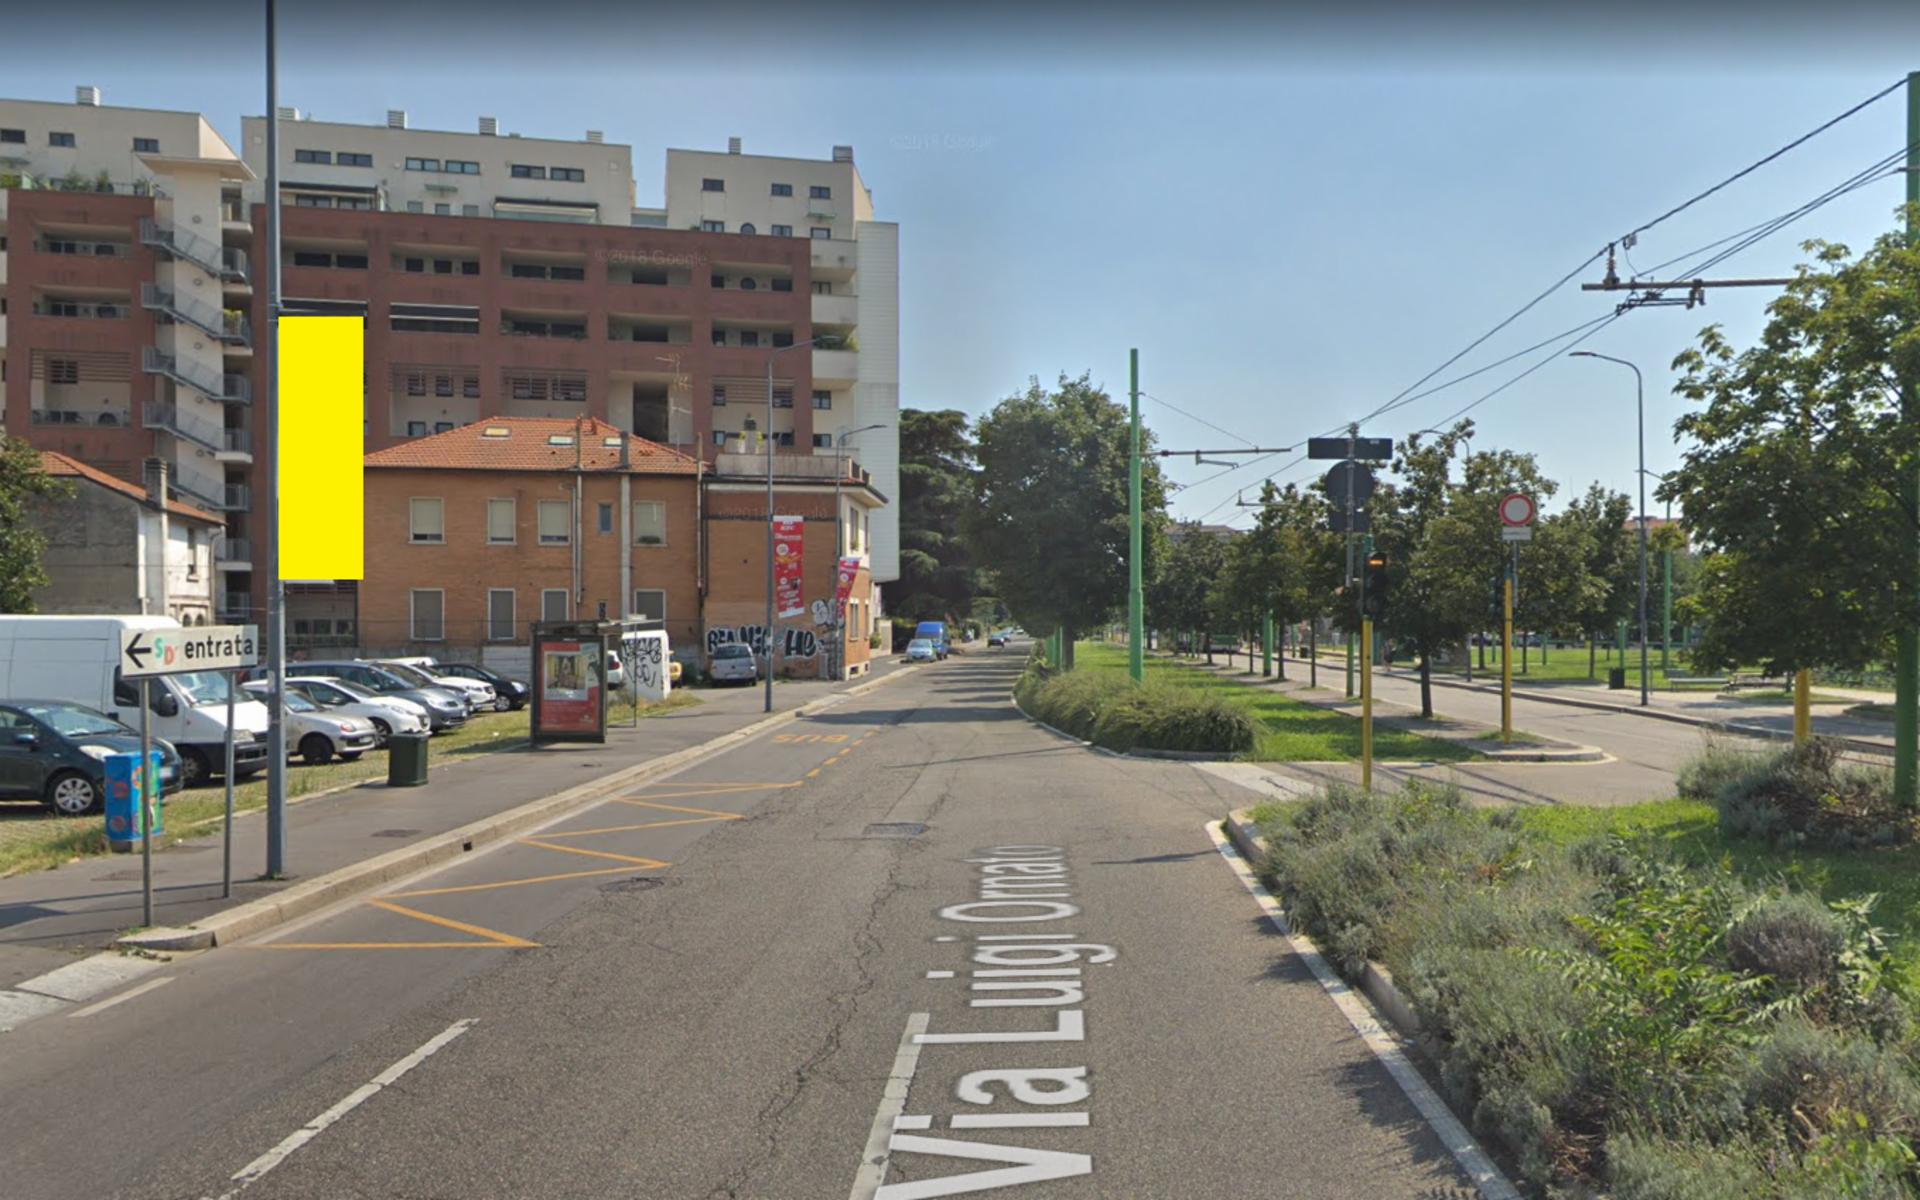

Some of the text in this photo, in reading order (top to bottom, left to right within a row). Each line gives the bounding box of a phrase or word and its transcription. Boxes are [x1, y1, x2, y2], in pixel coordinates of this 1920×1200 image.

[184, 634, 254, 659] entrata
[874, 845, 1117, 1200] Via Luigi Ornato
